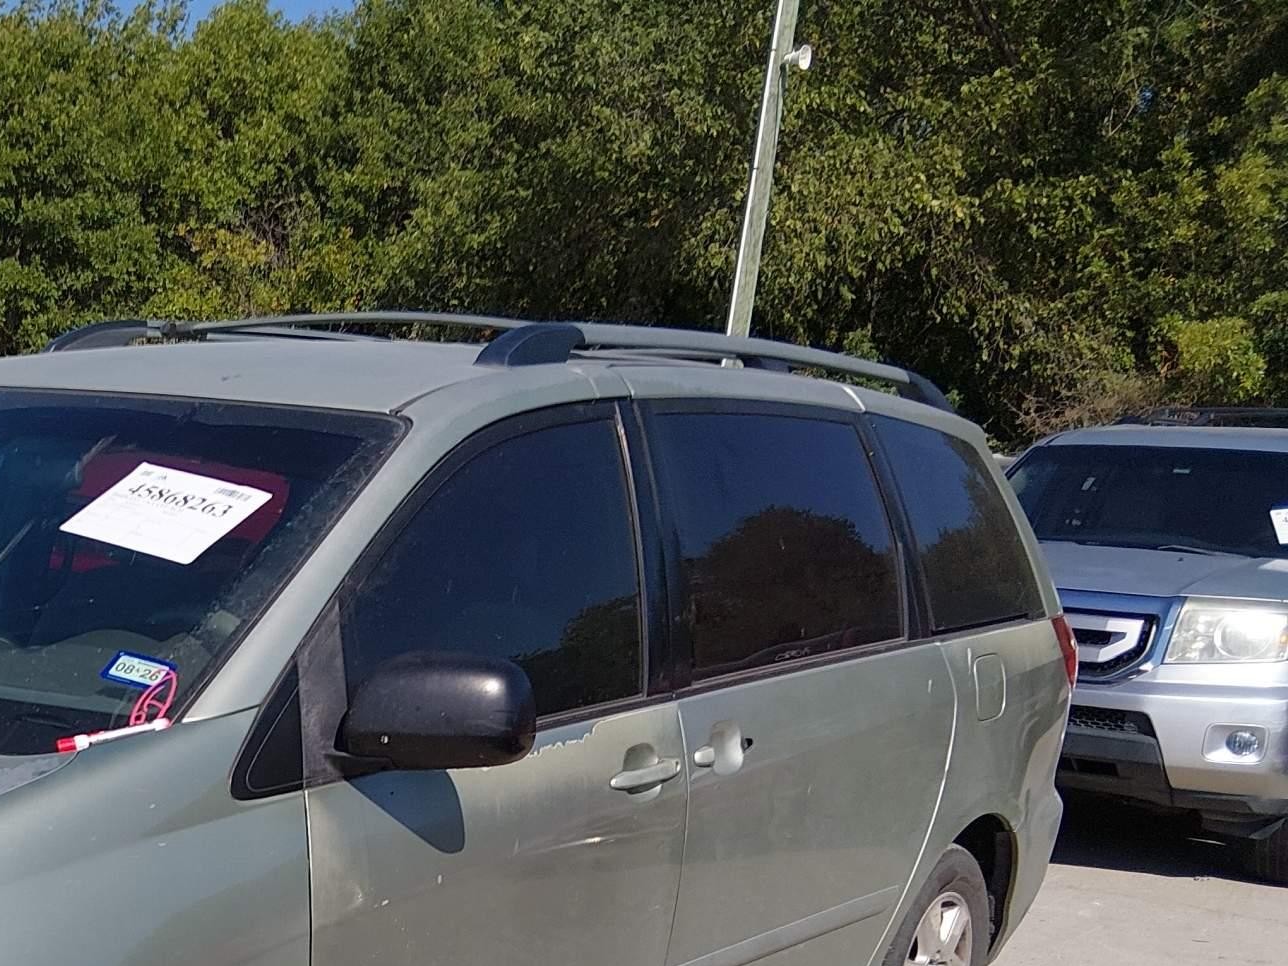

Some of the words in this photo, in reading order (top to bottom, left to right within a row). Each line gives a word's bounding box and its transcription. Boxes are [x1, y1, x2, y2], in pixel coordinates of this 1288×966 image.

[128, 483, 233, 518] 45868263
[115, 662, 135, 675] 08
[139, 668, 161, 682] 26
